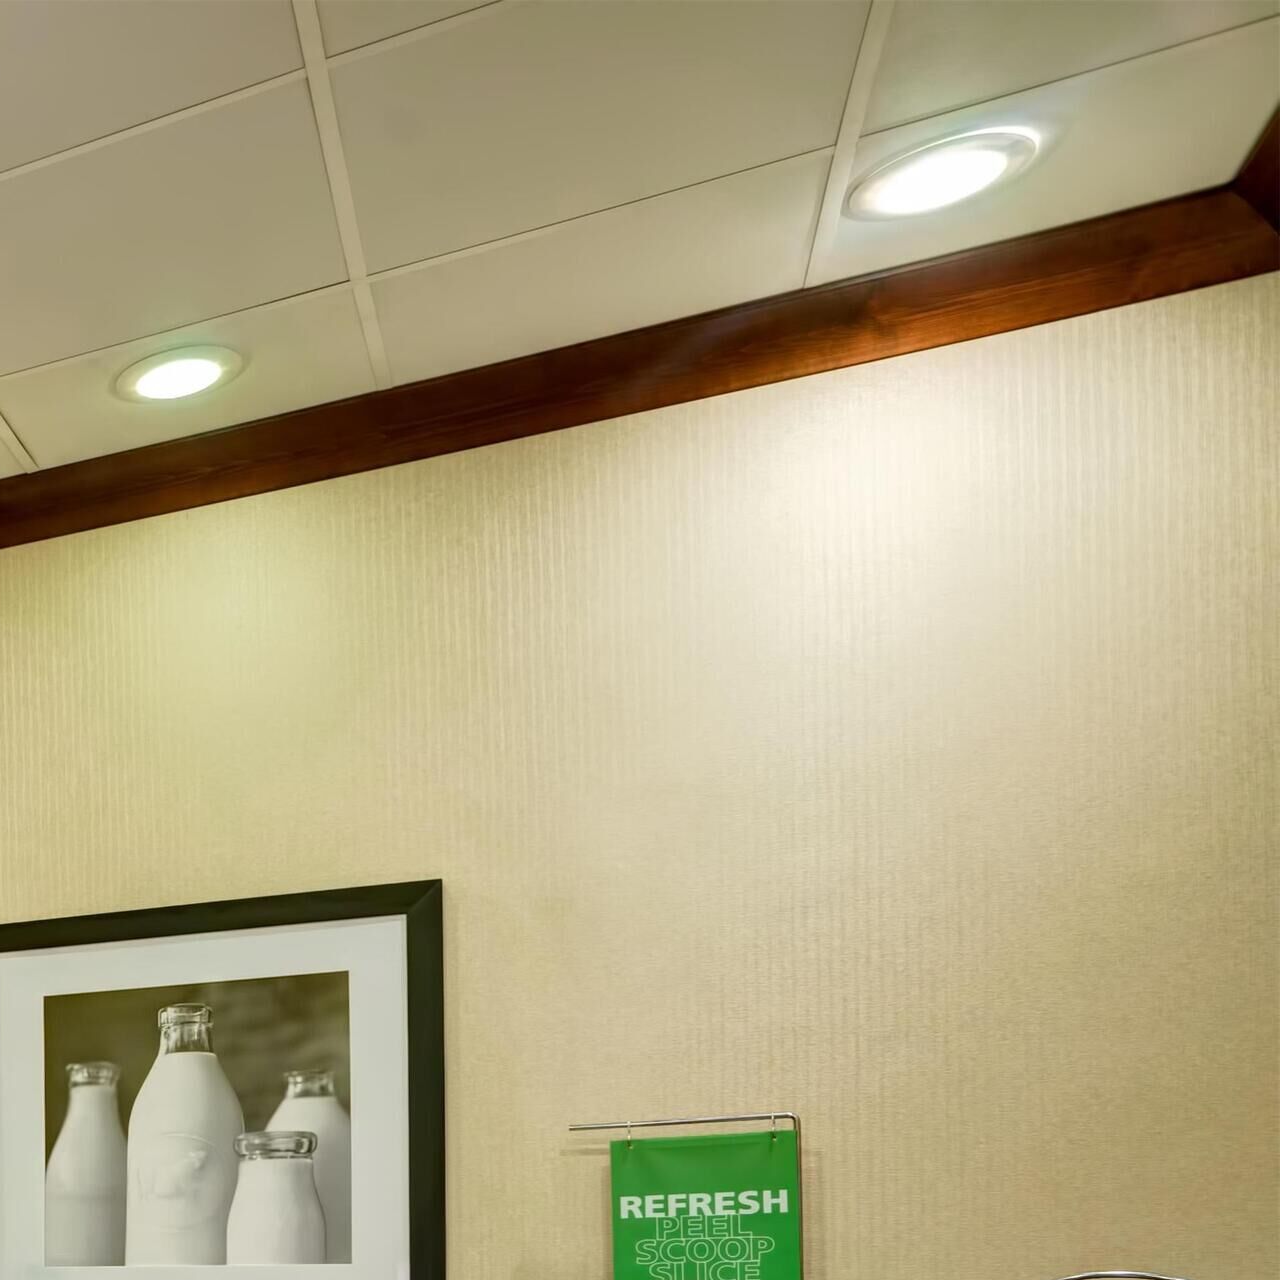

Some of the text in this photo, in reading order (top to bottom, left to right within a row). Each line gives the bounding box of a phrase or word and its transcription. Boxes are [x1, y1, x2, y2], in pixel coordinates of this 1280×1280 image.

[619, 1189, 789, 1219] REFRESH
[655, 1213, 753, 1241] PEEL
[634, 1235, 776, 1265] SCOOP
